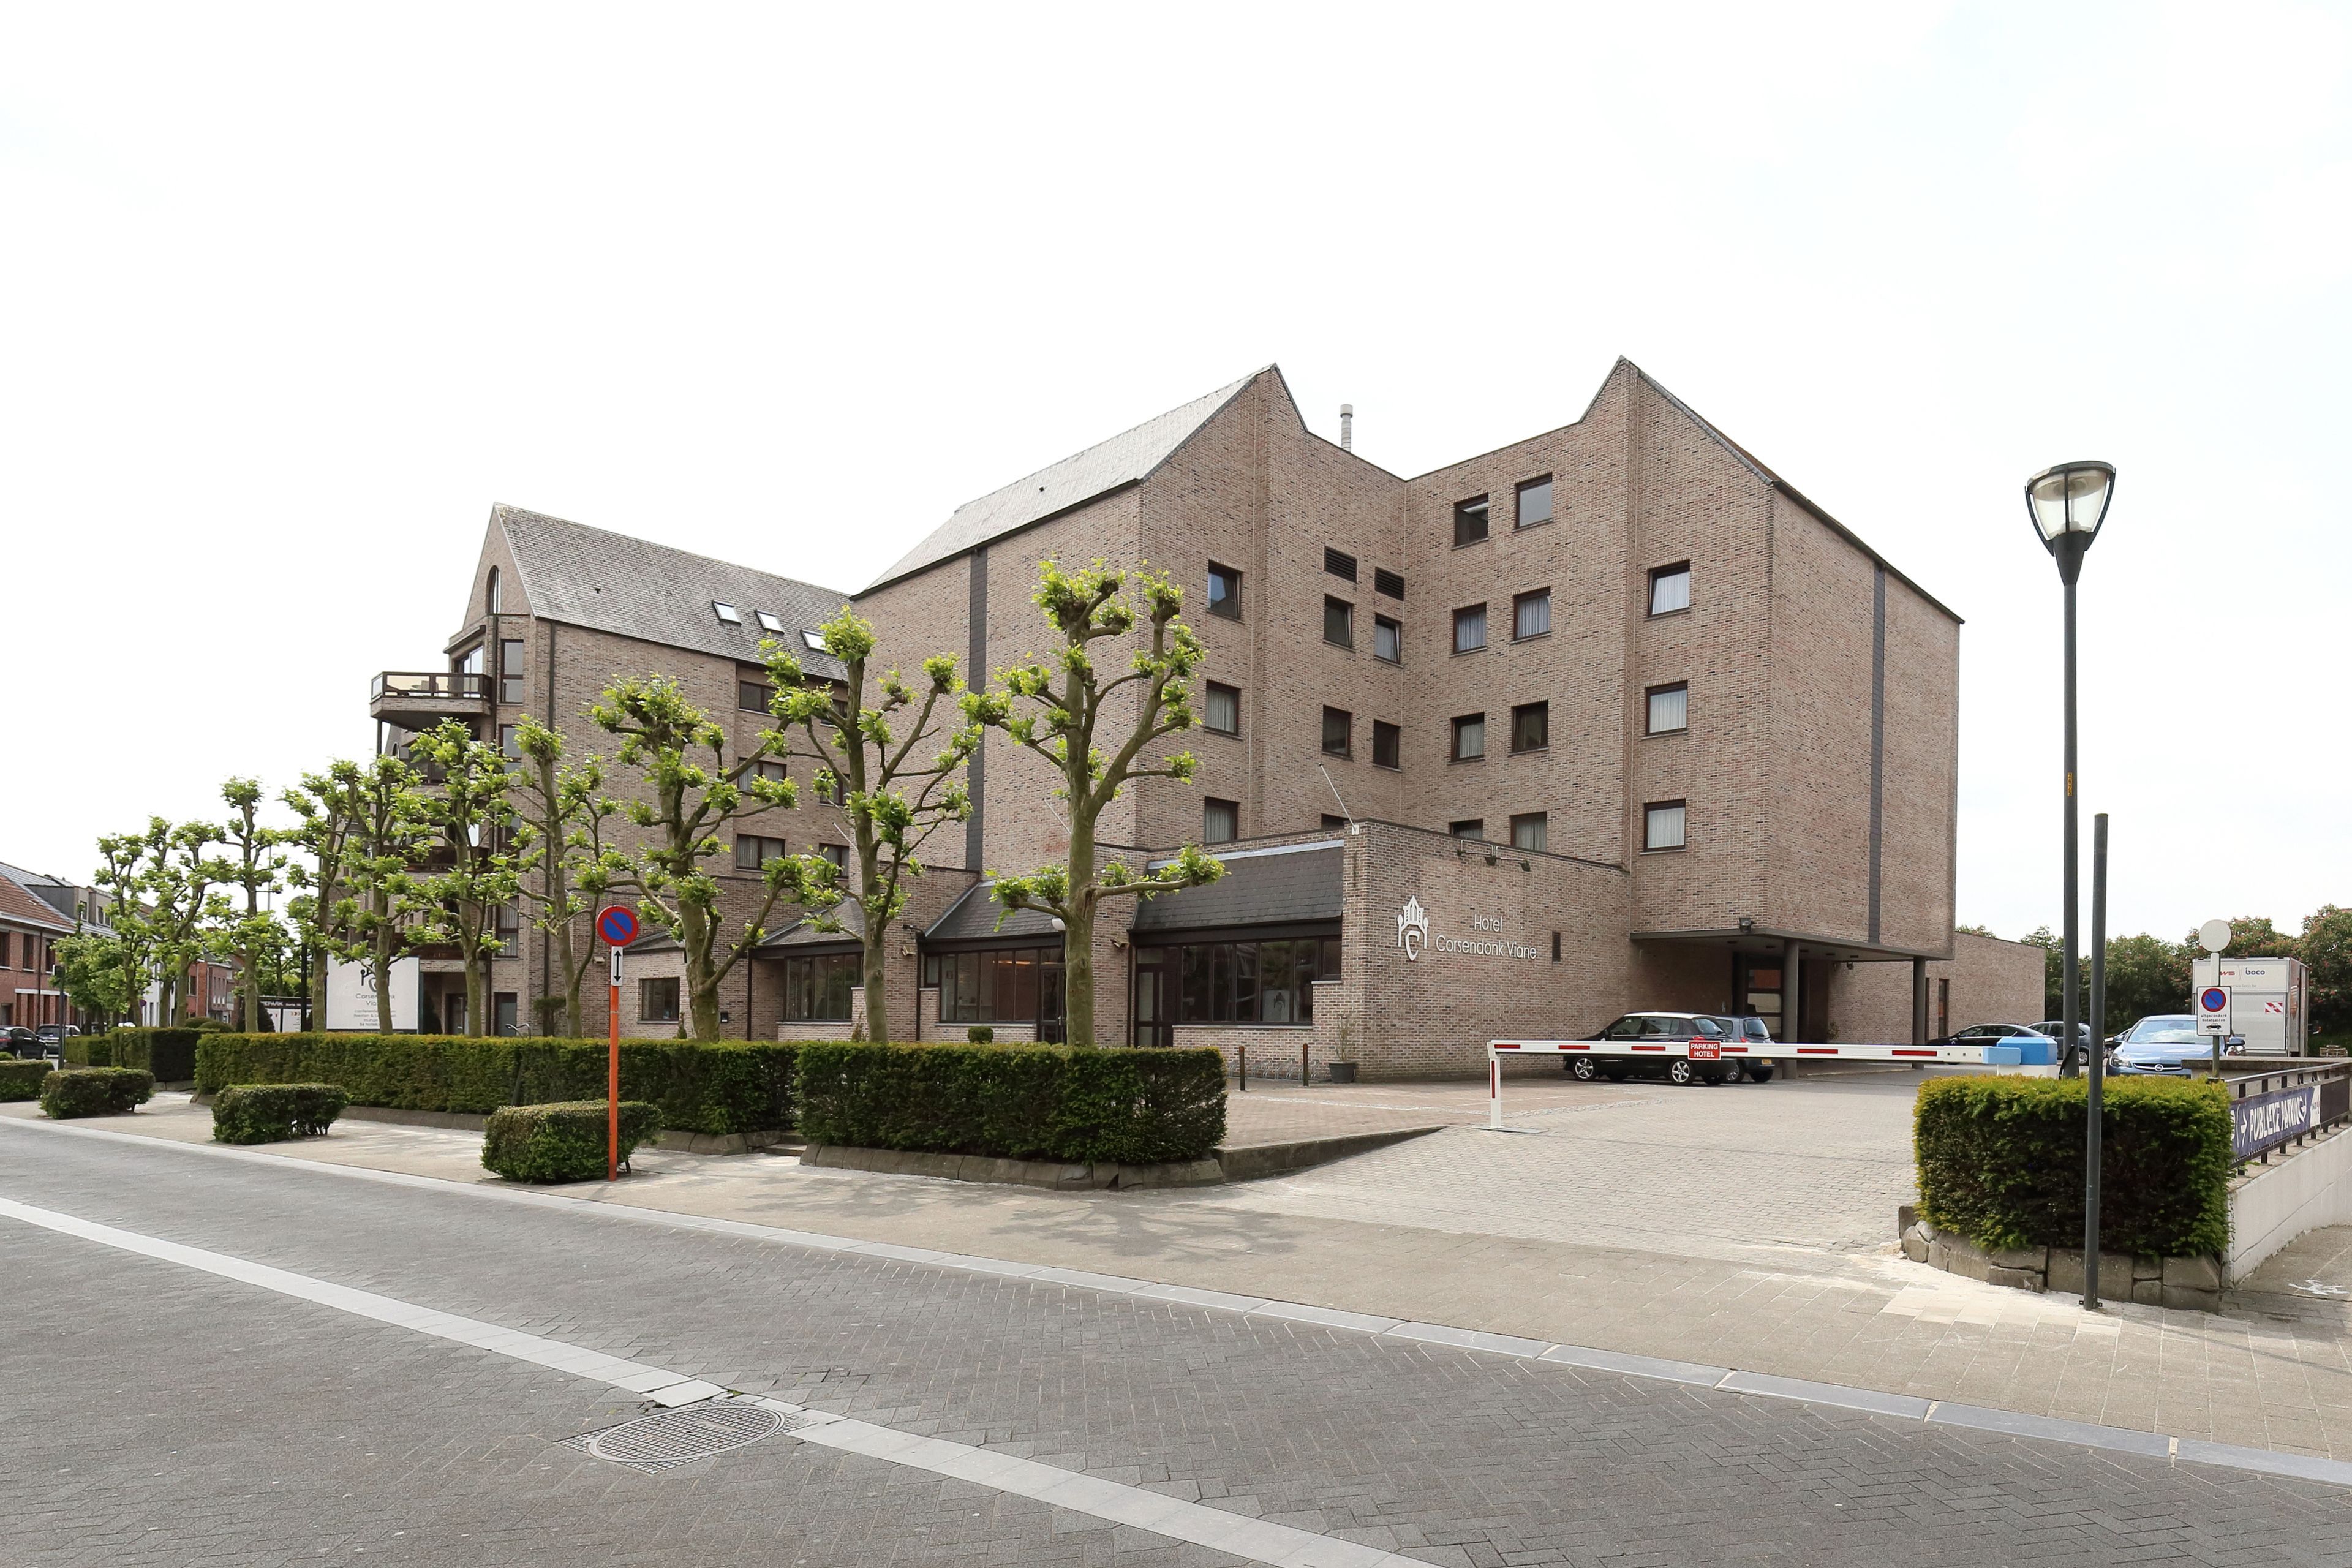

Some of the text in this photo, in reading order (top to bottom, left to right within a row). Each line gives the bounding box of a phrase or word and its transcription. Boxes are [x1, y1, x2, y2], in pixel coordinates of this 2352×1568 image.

[1474, 914, 1502, 932] Hotel
[1436, 935, 1537, 960] Corsendonk Viane
[2245, 967, 2266, 976] boco
